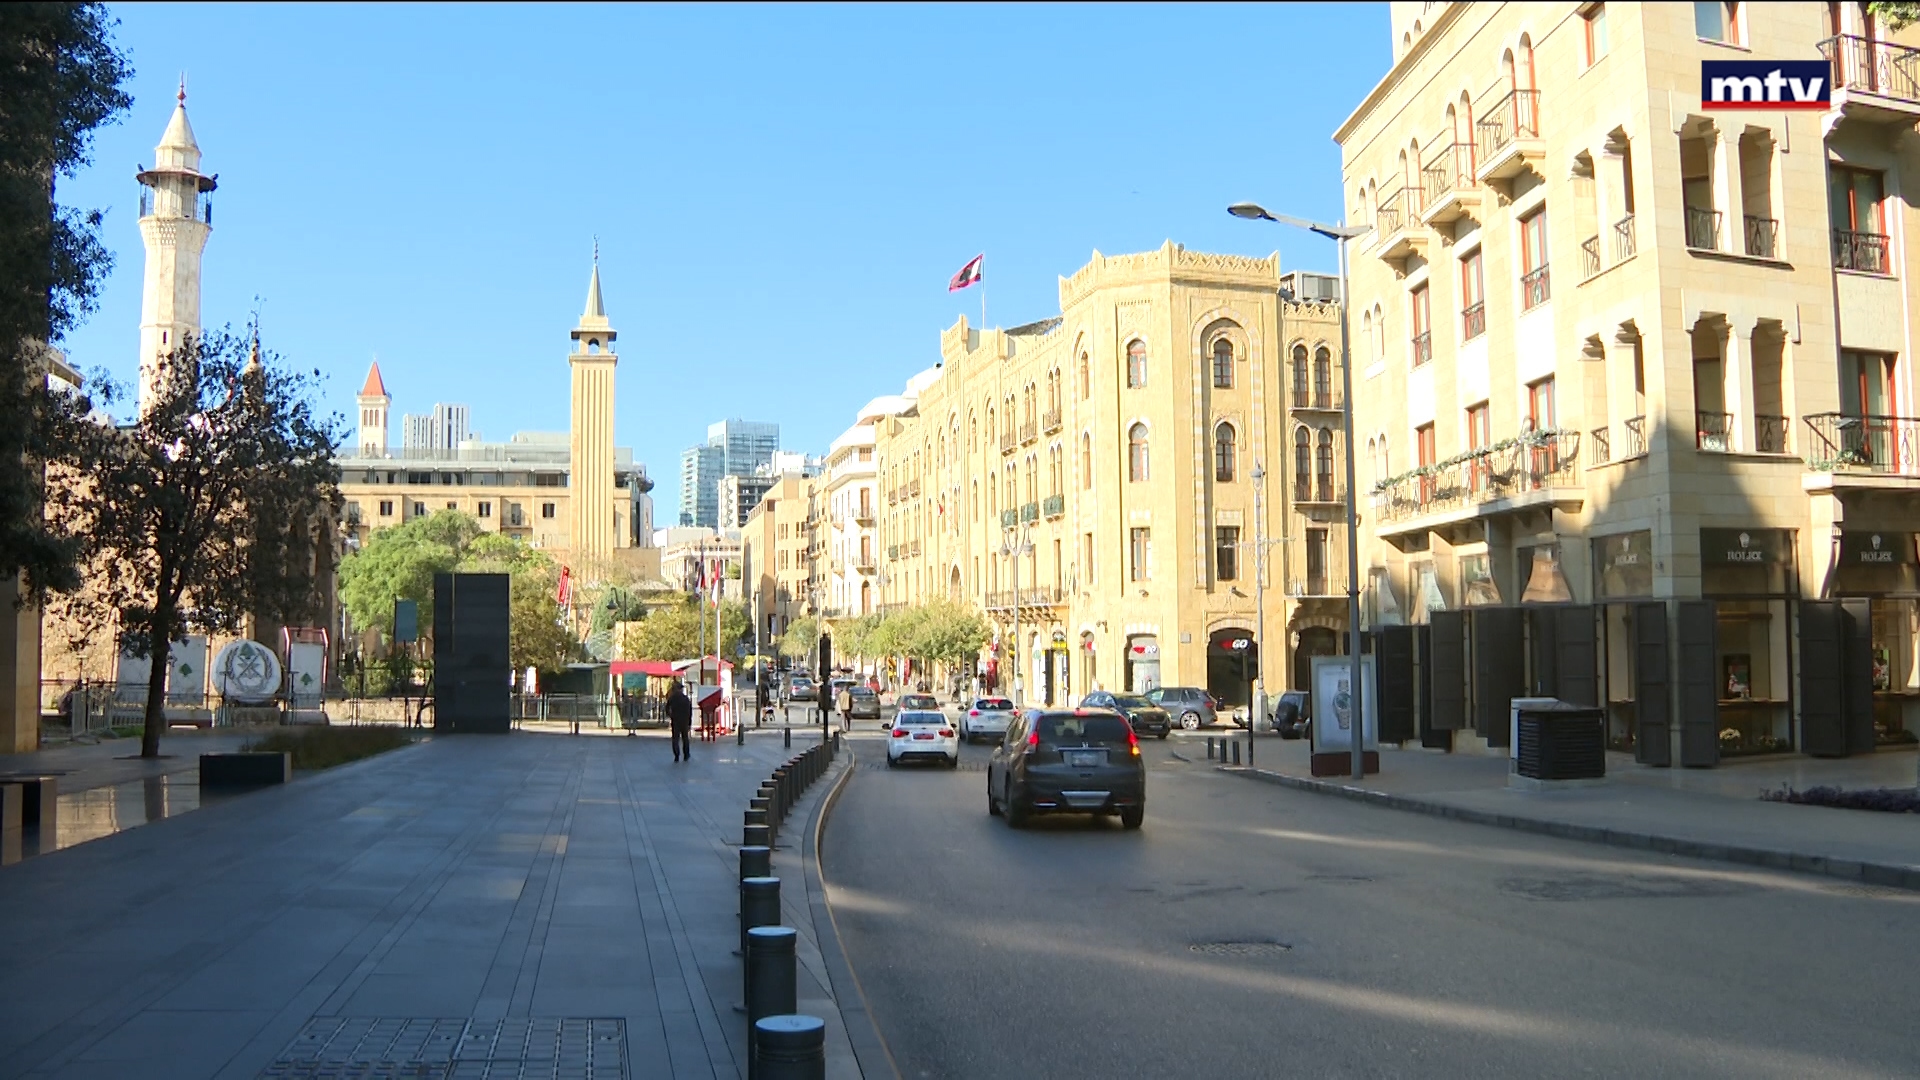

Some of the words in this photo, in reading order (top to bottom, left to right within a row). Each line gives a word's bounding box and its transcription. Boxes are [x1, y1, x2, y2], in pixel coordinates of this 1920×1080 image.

[1727, 551, 1763, 561] ROLEX
[1860, 551, 1892, 562] ROLEX
[1232, 639, 1248, 649] GO
